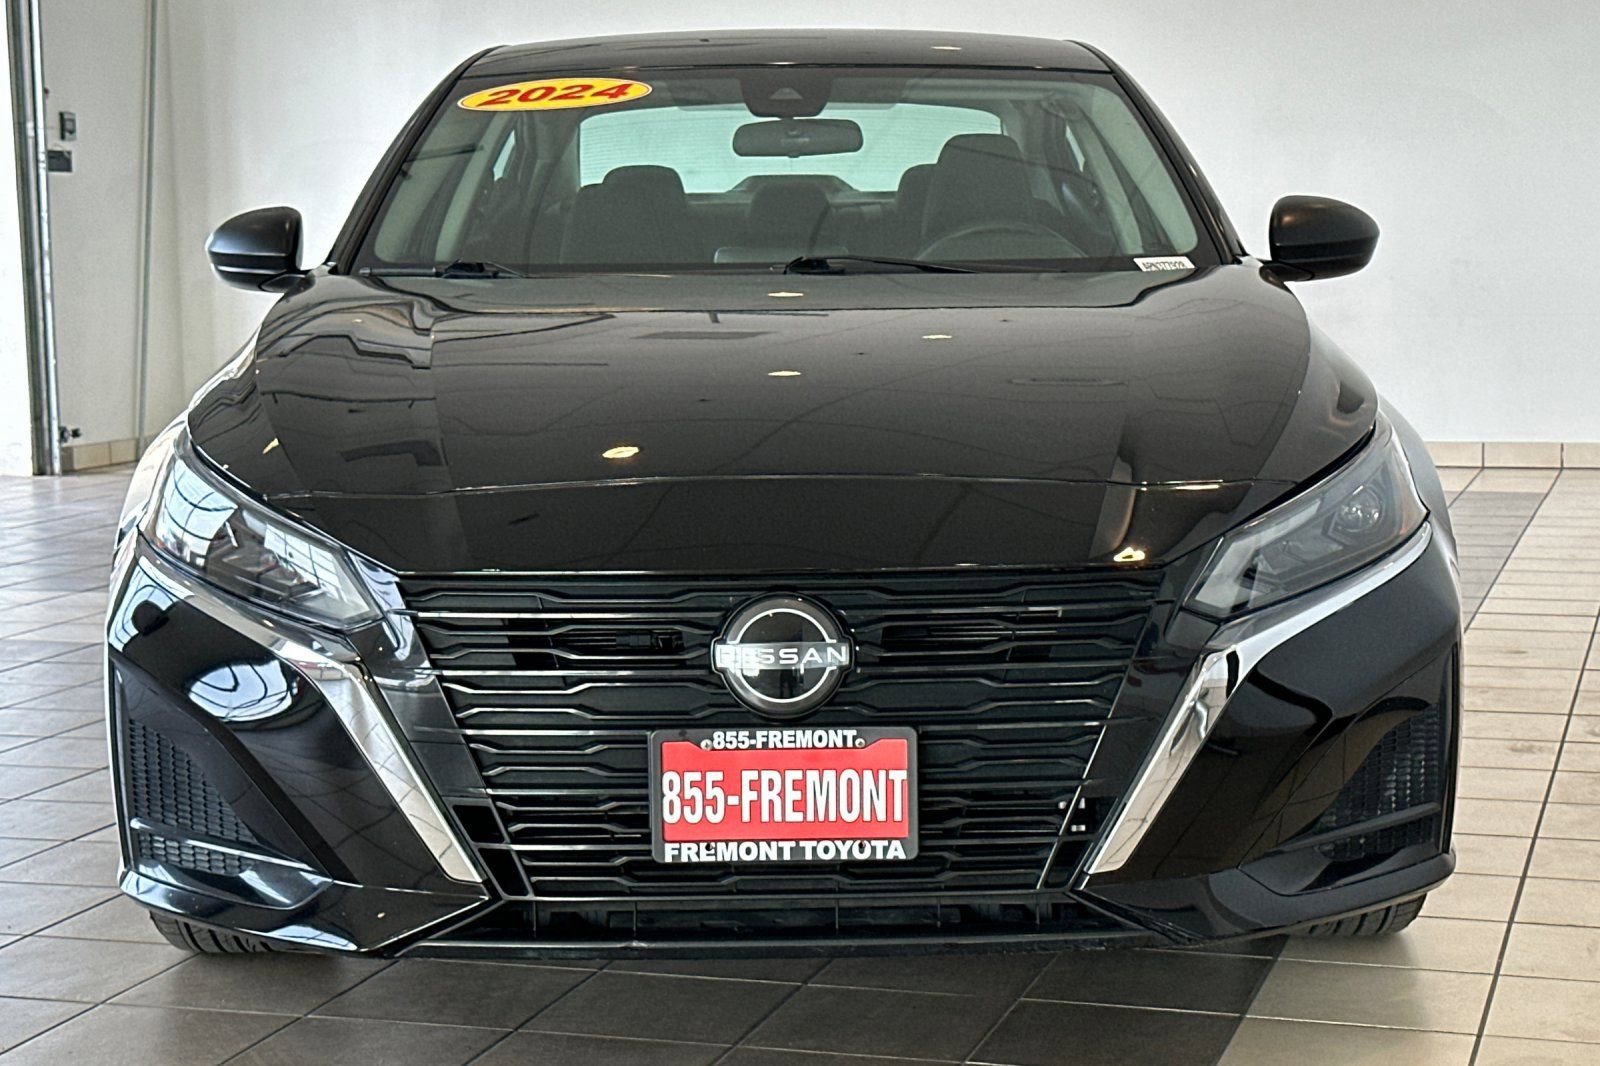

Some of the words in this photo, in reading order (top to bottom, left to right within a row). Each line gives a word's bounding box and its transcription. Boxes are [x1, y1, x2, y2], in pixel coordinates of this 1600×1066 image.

[475, 83, 634, 107] 2024
[717, 645, 846, 665] SSAN
[712, 730, 857, 750] 855-FREMONT
[662, 769, 908, 824] 855-FREMONT
[664, 842, 796, 862] FREMONT
[799, 840, 906, 861] TOYOTA
